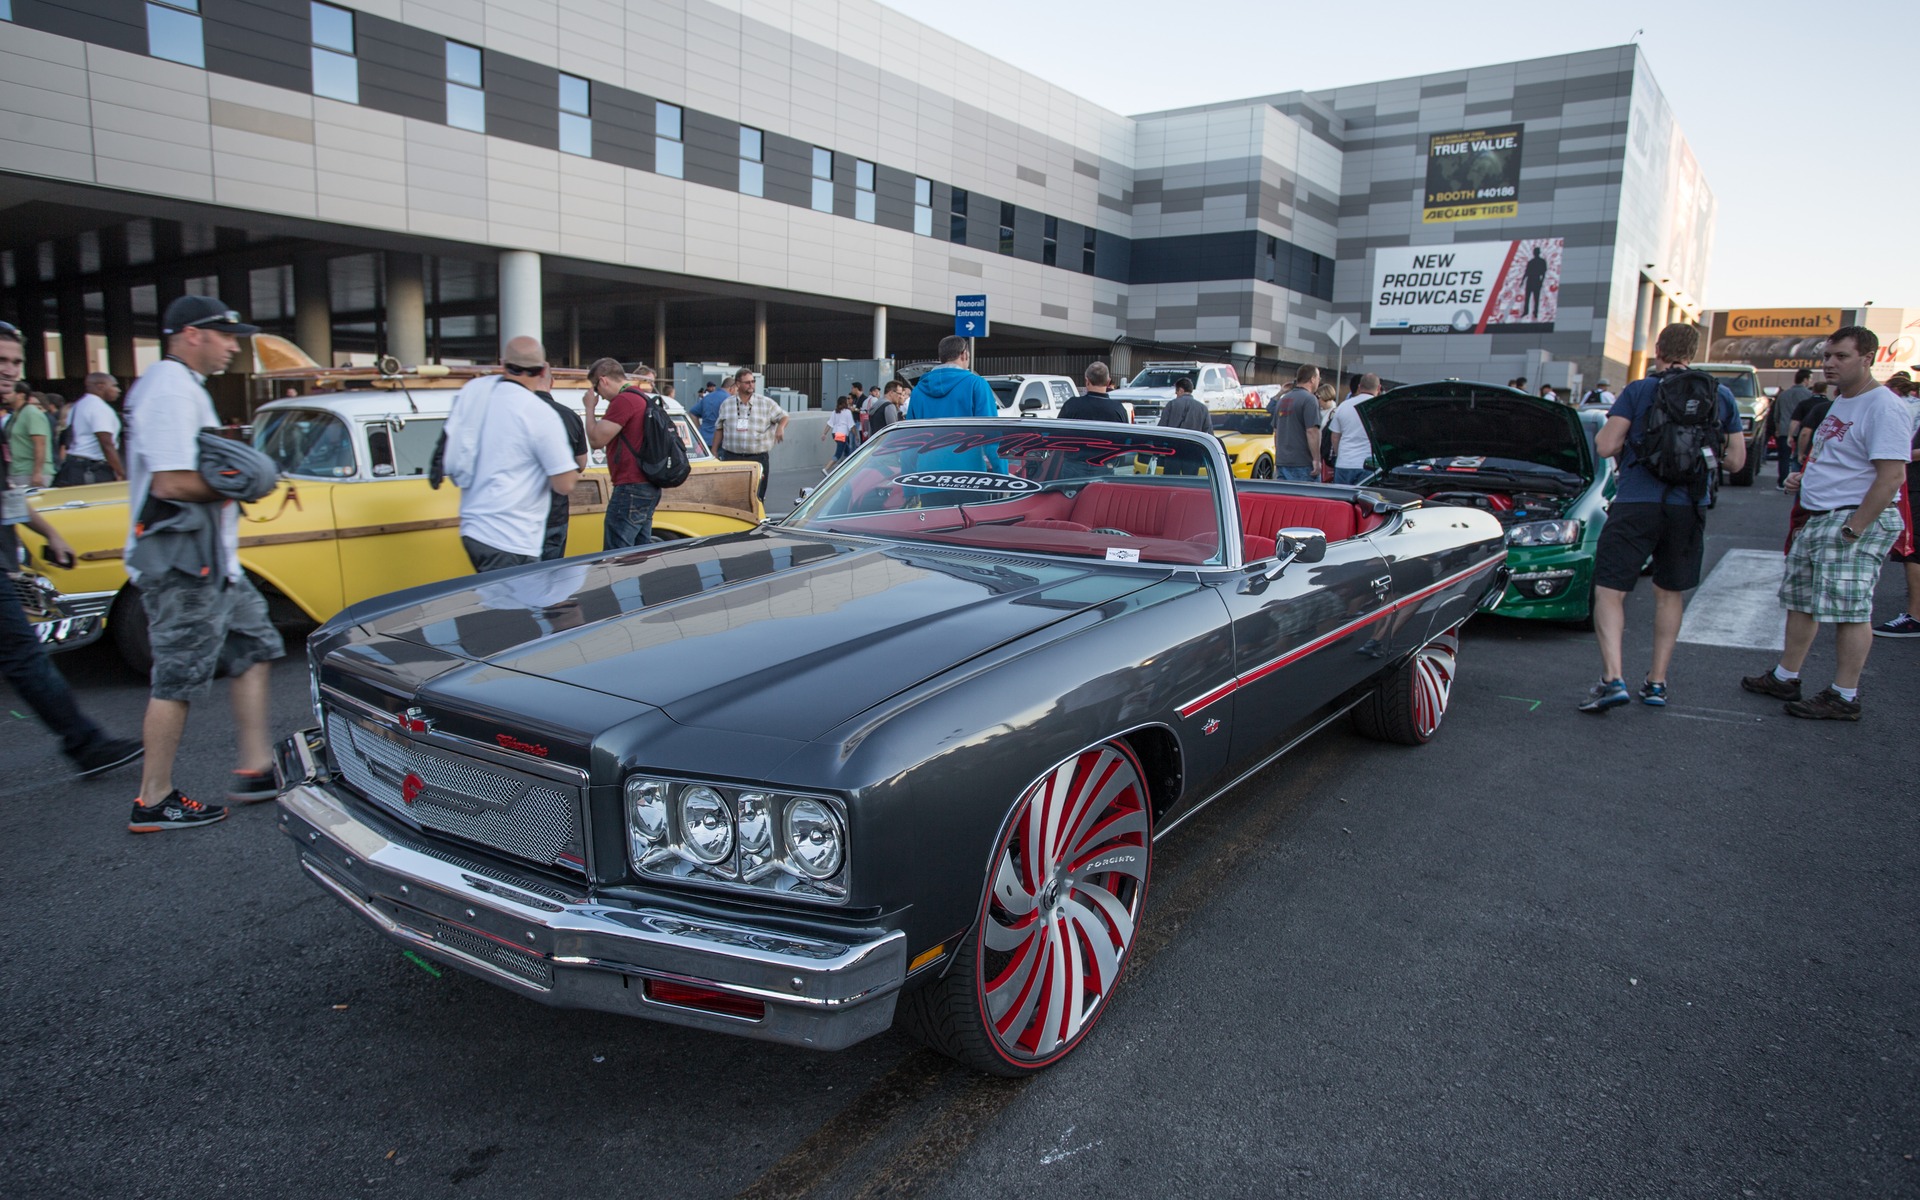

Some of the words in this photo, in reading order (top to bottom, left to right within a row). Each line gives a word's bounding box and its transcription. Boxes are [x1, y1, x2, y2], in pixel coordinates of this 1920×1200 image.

[1433, 142, 1469, 156] TRUE
[1471, 137, 1518, 152] VALUE.
[1436, 189, 1475, 202] BOOTH
[1477, 186, 1515, 198] #40186
[1424, 208, 1477, 219] AEOLUS
[1481, 204, 1514, 215] TIRES
[1412, 253, 1456, 269] NEW
[1382, 270, 1484, 288] PRODUCTS
[1379, 289, 1486, 306] SHOWCASE
[1411, 325, 1450, 333] UPSTAIRS
[1732, 314, 1821, 332] Continental
[1773, 358, 1813, 369] BOOTH
[901, 474, 1029, 490] FORGIATO
[1086, 855, 1136, 871] FORGIATO
